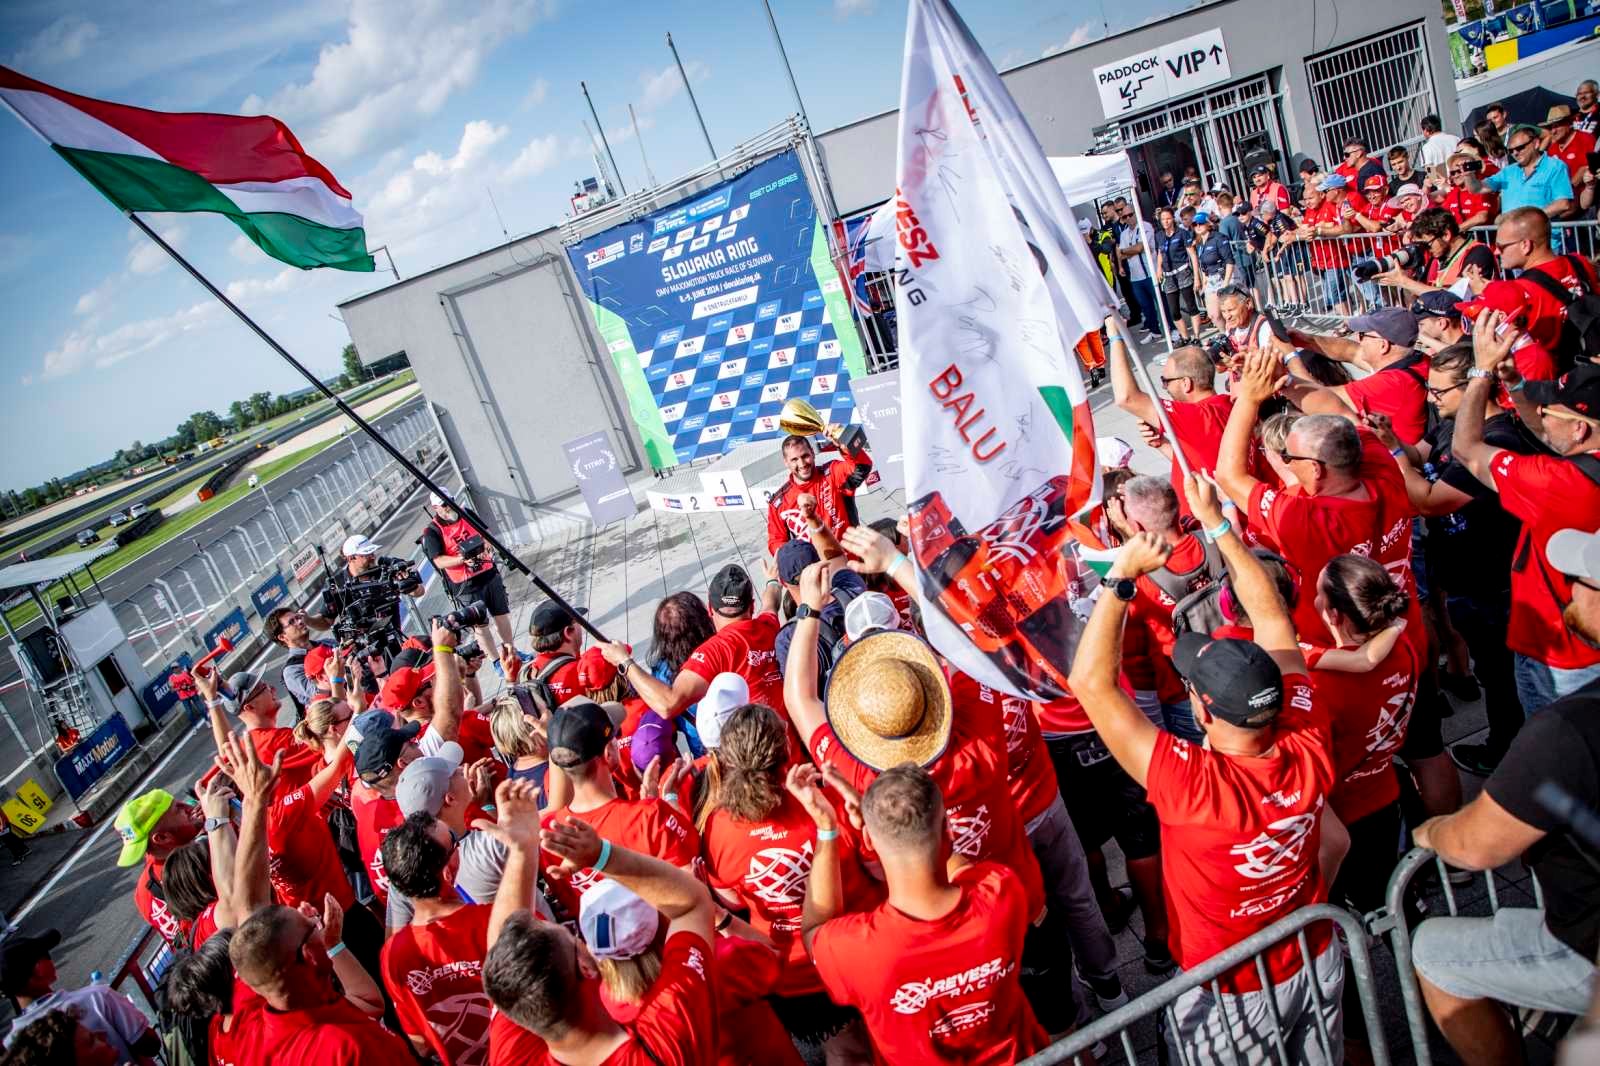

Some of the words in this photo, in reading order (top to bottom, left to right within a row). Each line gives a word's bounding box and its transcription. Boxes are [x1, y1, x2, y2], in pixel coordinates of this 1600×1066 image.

[1099, 56, 1159, 84] PADDOCK
[1166, 50, 1206, 78] VIP
[778, 173, 799, 188] SERIES
[729, 236, 759, 257] RING
[707, 269, 725, 282] TRUCK
[725, 265, 739, 277] RACE
[739, 263, 746, 271] OF
[929, 364, 1007, 463] BALU
[719, 478, 728, 493] 1
[690, 496, 700, 510] 2
[20, 814, 38, 827] 30
[934, 957, 1003, 992] REVESZ
